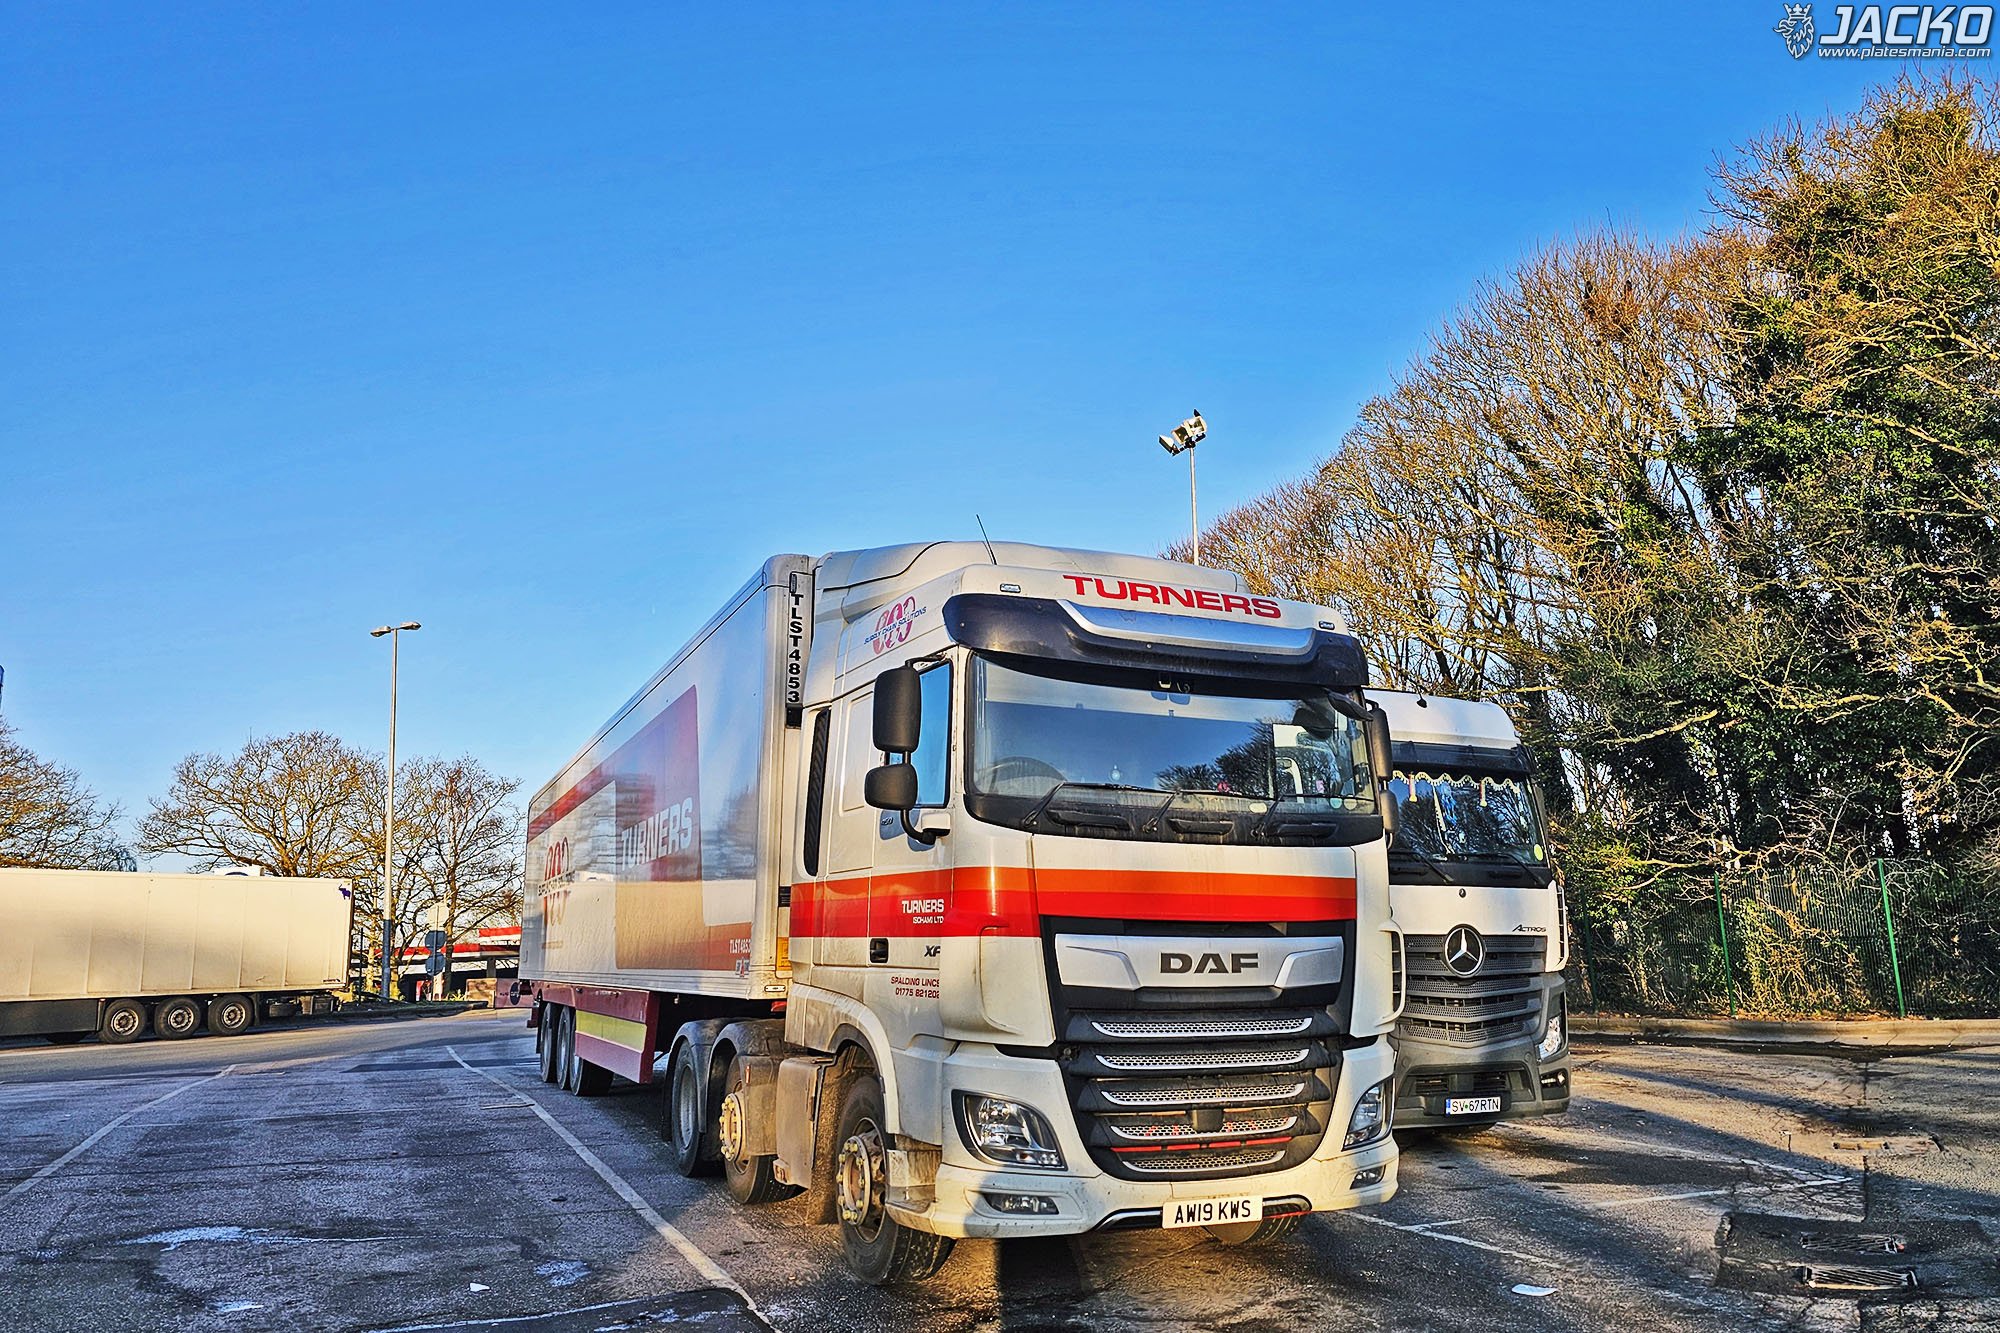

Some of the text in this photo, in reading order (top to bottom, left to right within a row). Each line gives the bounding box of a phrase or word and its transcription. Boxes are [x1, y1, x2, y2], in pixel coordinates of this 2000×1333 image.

[1062, 575, 1282, 618] TURNERS
[788, 593, 804, 702] TLST4853
[621, 796, 693, 871] TURNERS
[901, 898, 945, 914] TURNERS
[933, 915, 945, 924] LTD
[1160, 952, 1259, 974] DAF
[890, 976, 920, 986] SPALDING
[895, 987, 914, 997] 01775
[1174, 1199, 1251, 1225] AW19 KWS
